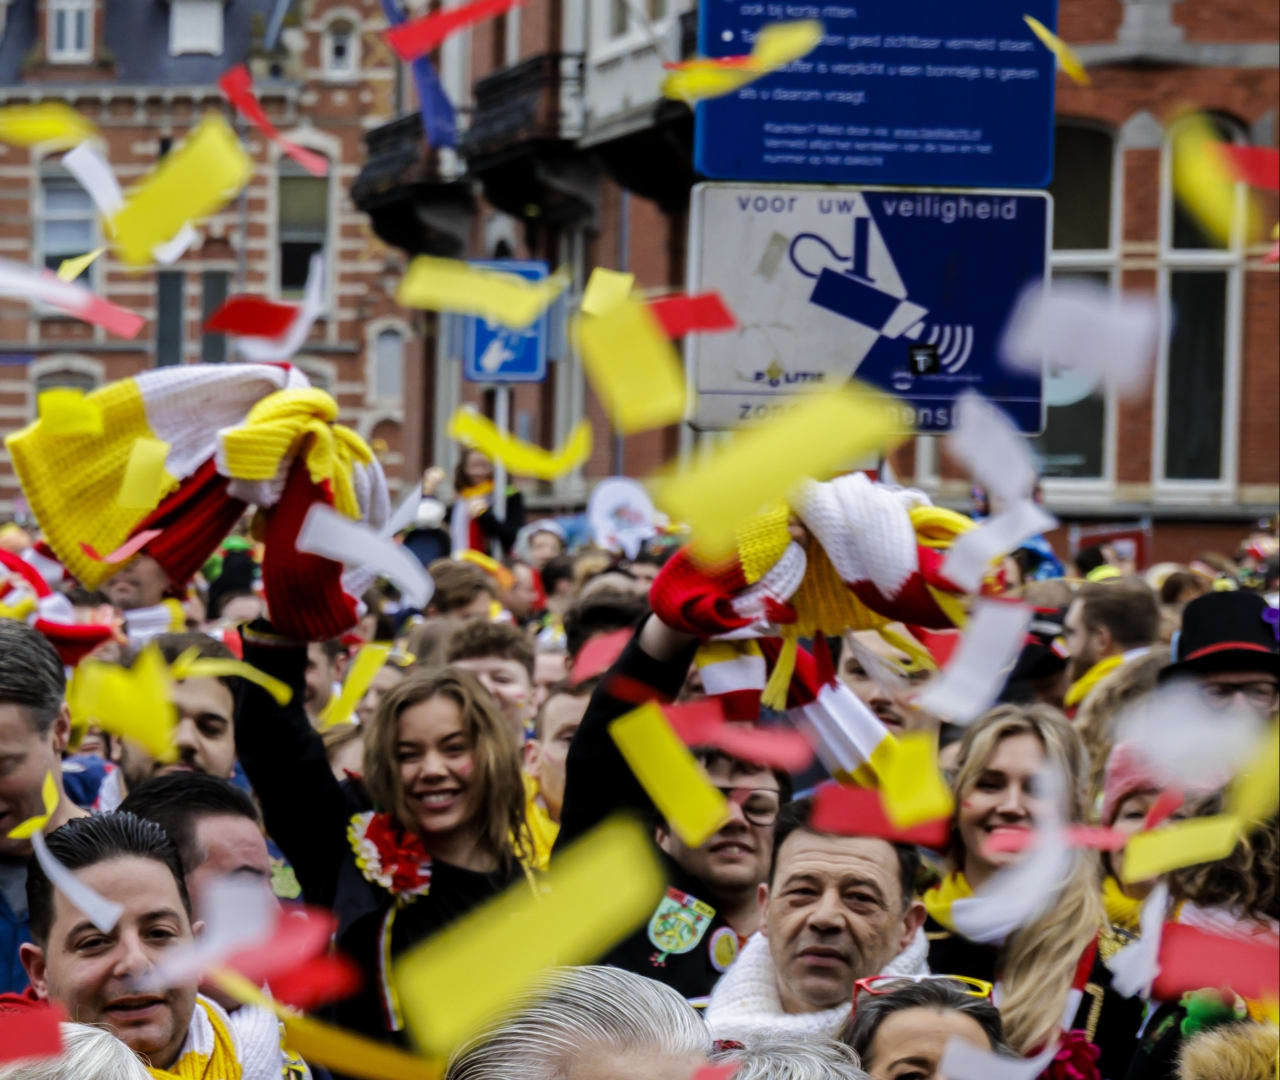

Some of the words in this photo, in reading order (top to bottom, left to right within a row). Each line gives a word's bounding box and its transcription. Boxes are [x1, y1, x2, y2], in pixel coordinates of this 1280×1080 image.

[737, 196, 797, 214] voor
[819, 197, 855, 215] uw
[883, 195, 1017, 223] veiligheid
